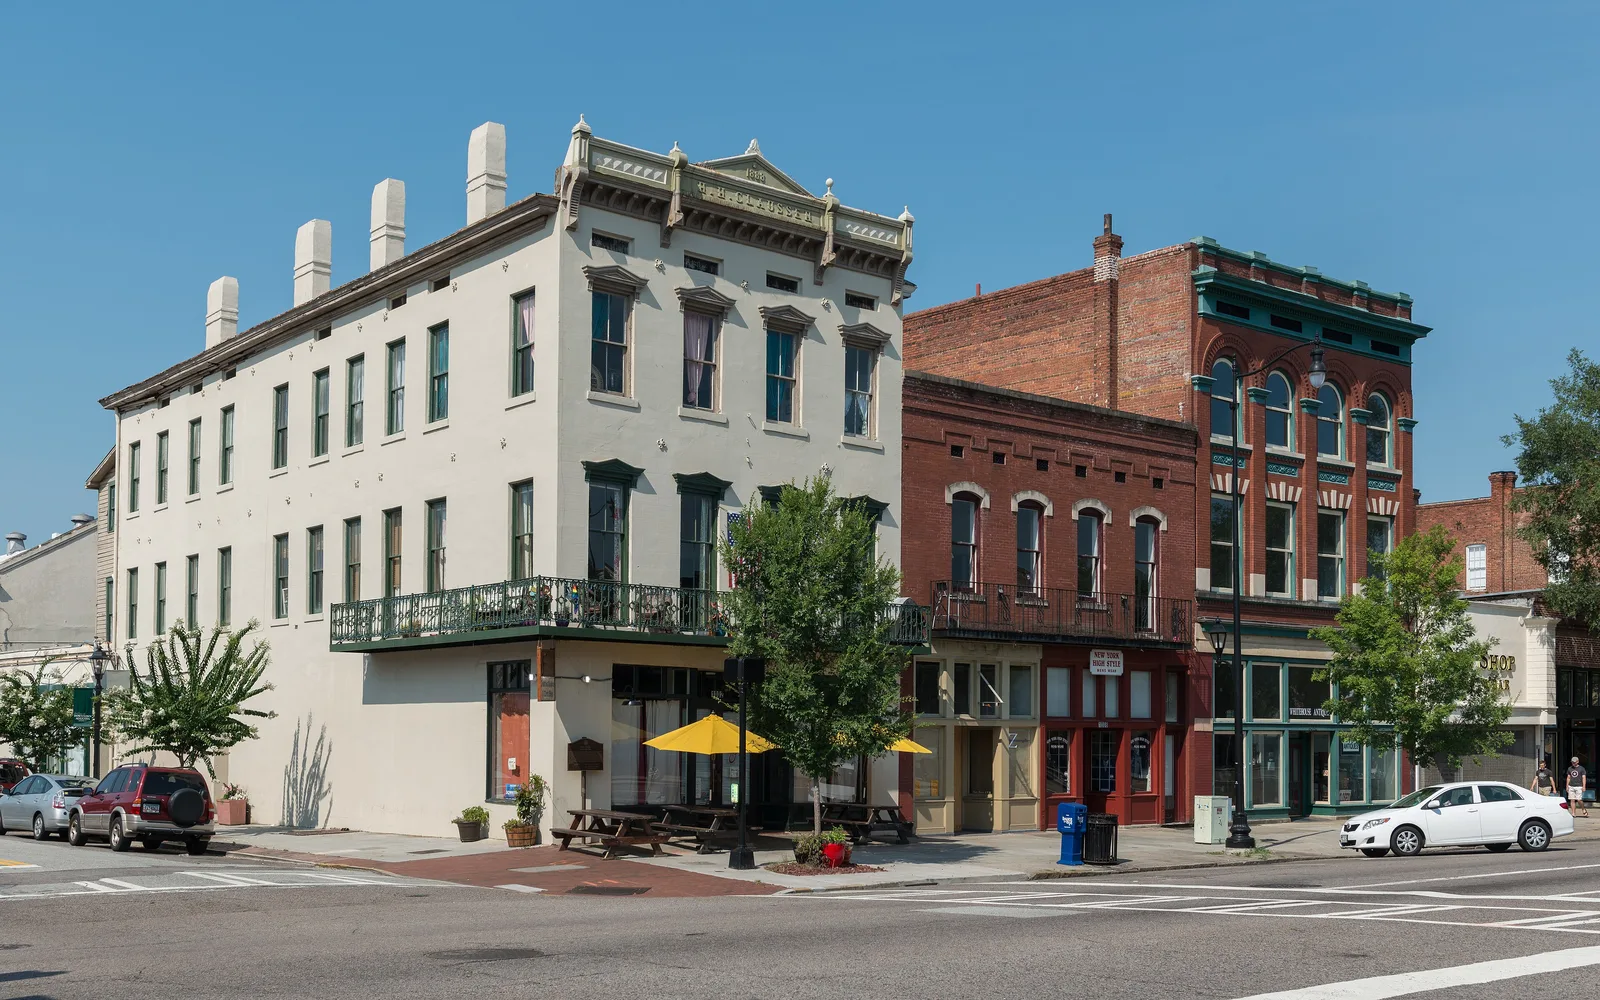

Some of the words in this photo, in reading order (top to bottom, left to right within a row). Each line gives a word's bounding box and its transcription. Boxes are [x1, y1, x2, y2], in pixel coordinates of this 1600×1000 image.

[1107, 651, 1120, 659] YORK
[1093, 659, 1106, 667] HIGH
[1290, 708, 1311, 716] WHITEHOUSE
